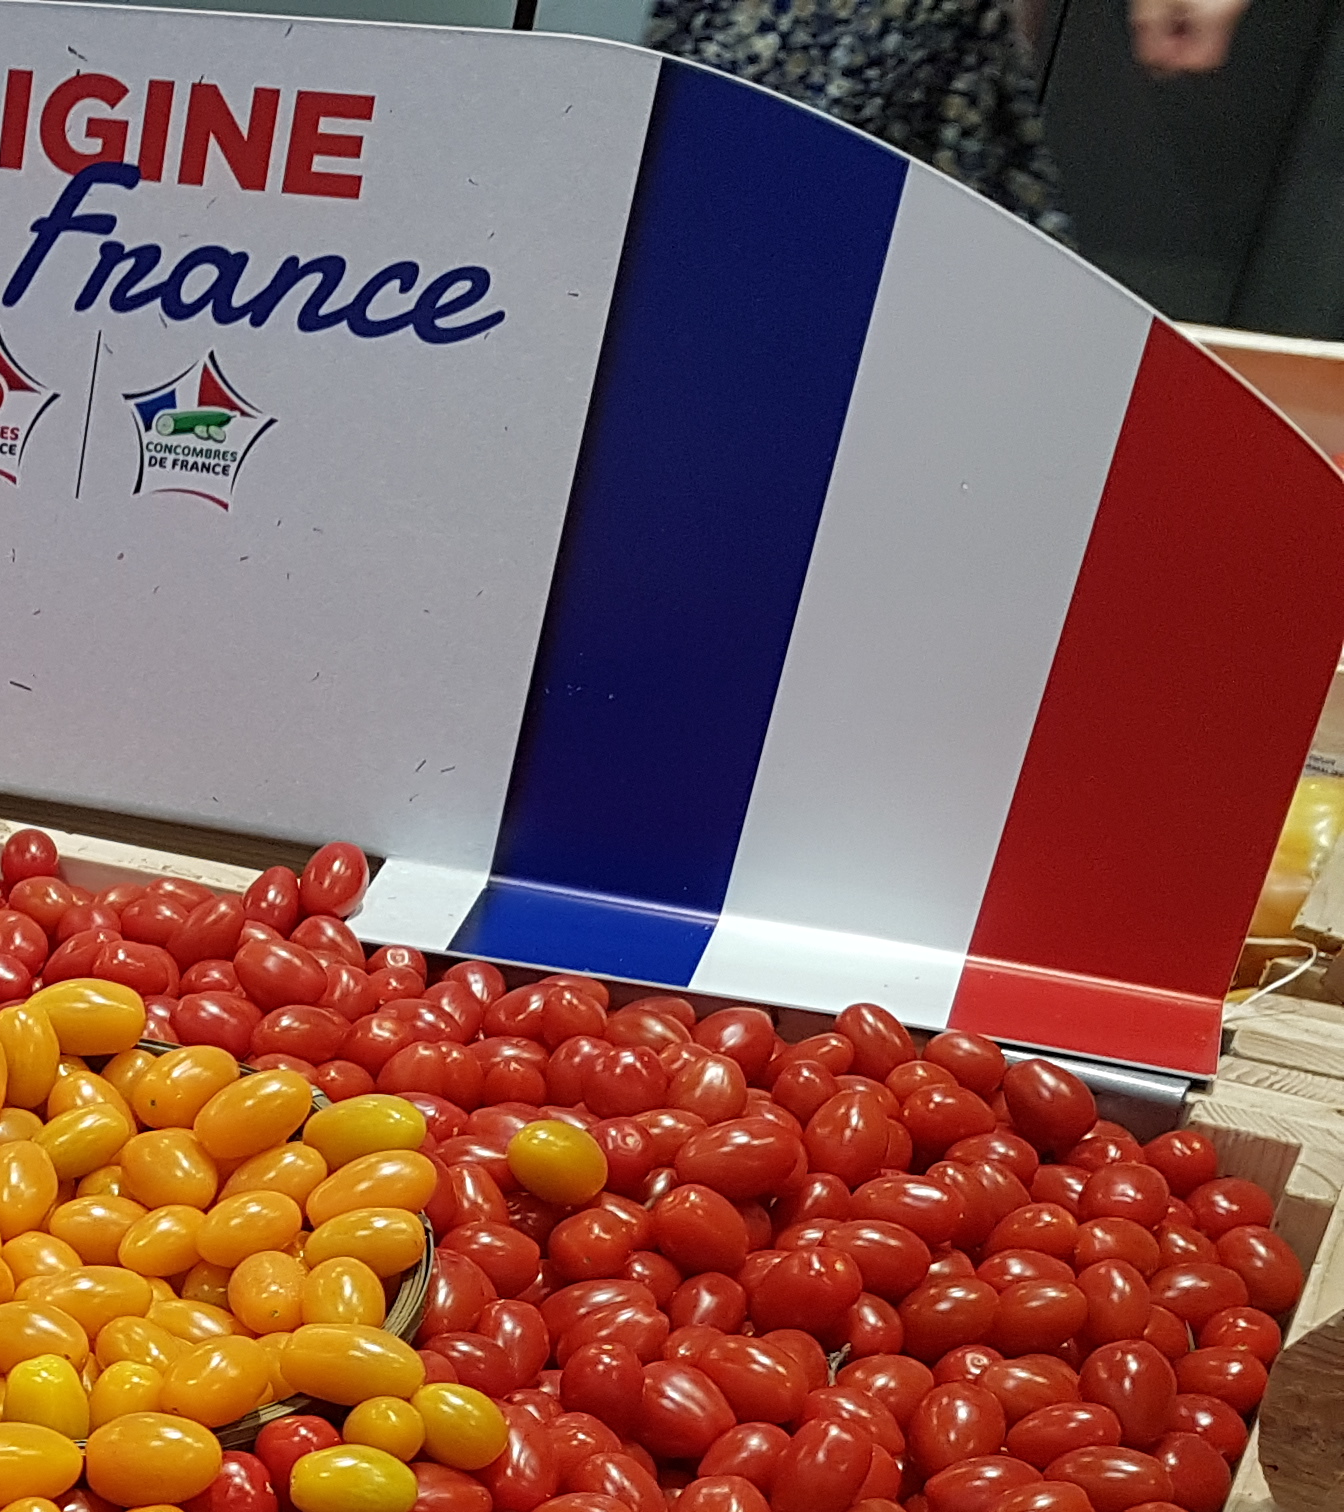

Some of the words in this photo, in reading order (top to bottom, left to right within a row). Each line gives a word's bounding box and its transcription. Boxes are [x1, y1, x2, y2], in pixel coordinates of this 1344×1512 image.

[145, 440, 238, 464] CONCOMBRES
[147, 455, 168, 470] DE
[171, 458, 231, 478] FRANCE
